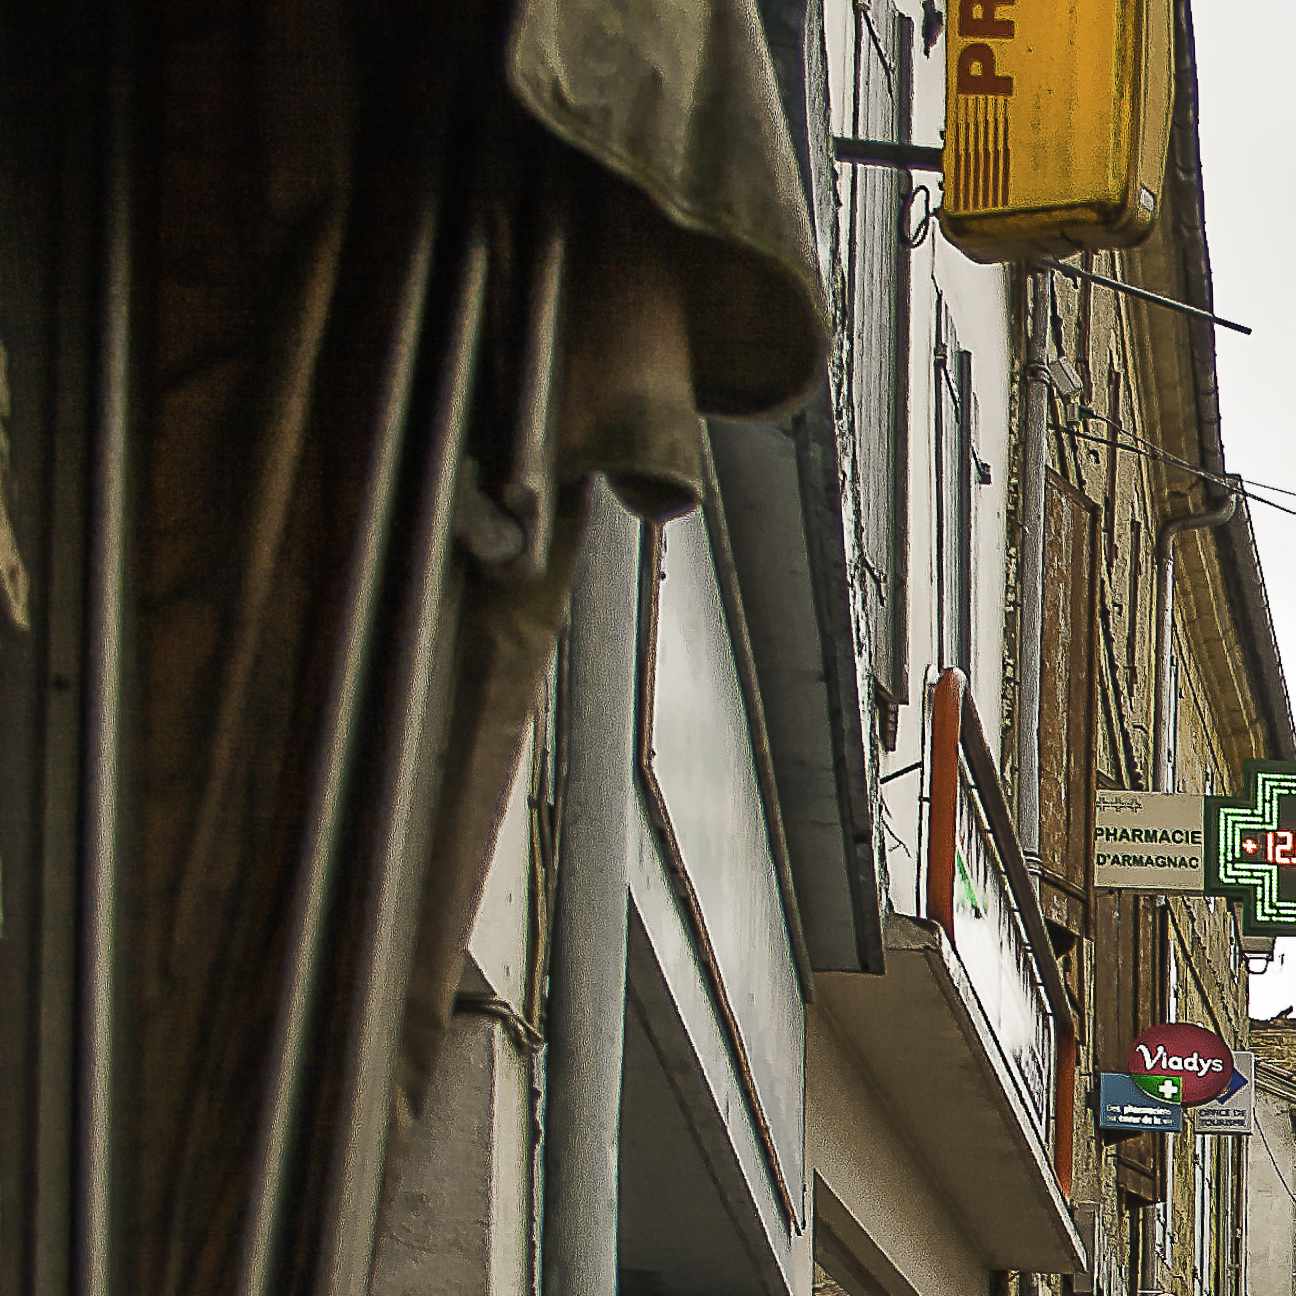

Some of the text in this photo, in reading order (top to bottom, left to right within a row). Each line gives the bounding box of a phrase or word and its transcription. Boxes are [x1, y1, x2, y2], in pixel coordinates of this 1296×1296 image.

[1095, 827, 1202, 846] PHARMACIE
[1096, 854, 1199, 870] D'ARMAGNAC
[1135, 1044, 1224, 1077] Viadys
